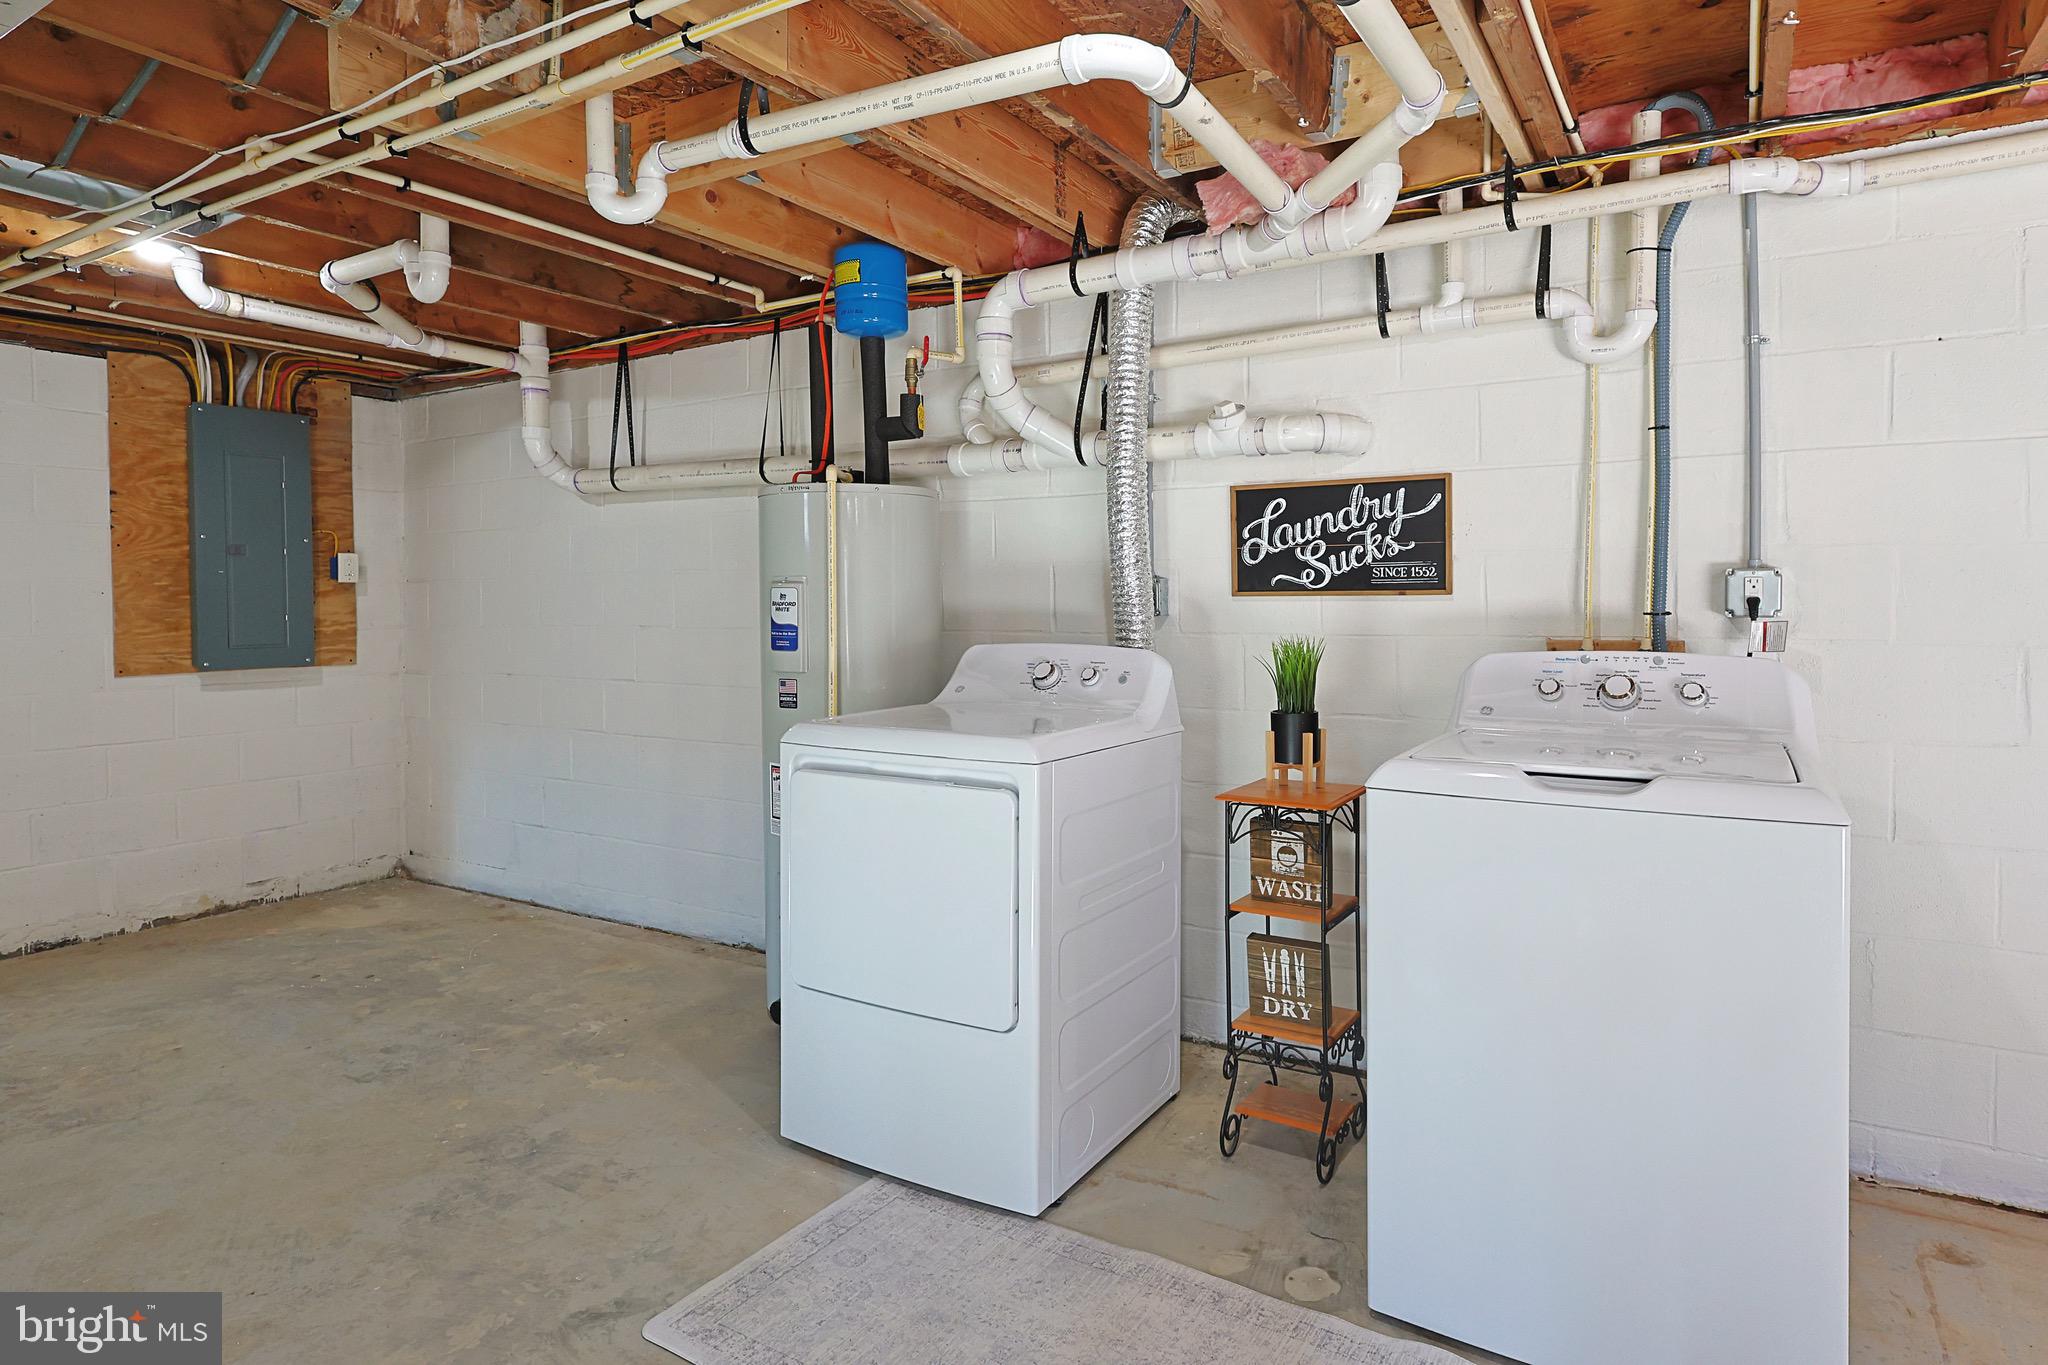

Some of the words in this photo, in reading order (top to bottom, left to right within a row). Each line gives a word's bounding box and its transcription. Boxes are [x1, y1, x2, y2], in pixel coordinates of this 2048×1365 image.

[893, 101, 914, 111] PRESSURE
[1241, 484, 1442, 567] Laundry
[1271, 522, 1416, 590] Sucks
[1372, 566, 1407, 578] SINCE
[1410, 566, 1437, 578] 1552
[1255, 875, 1322, 903] WASH
[1262, 995, 1313, 1021] DRY
